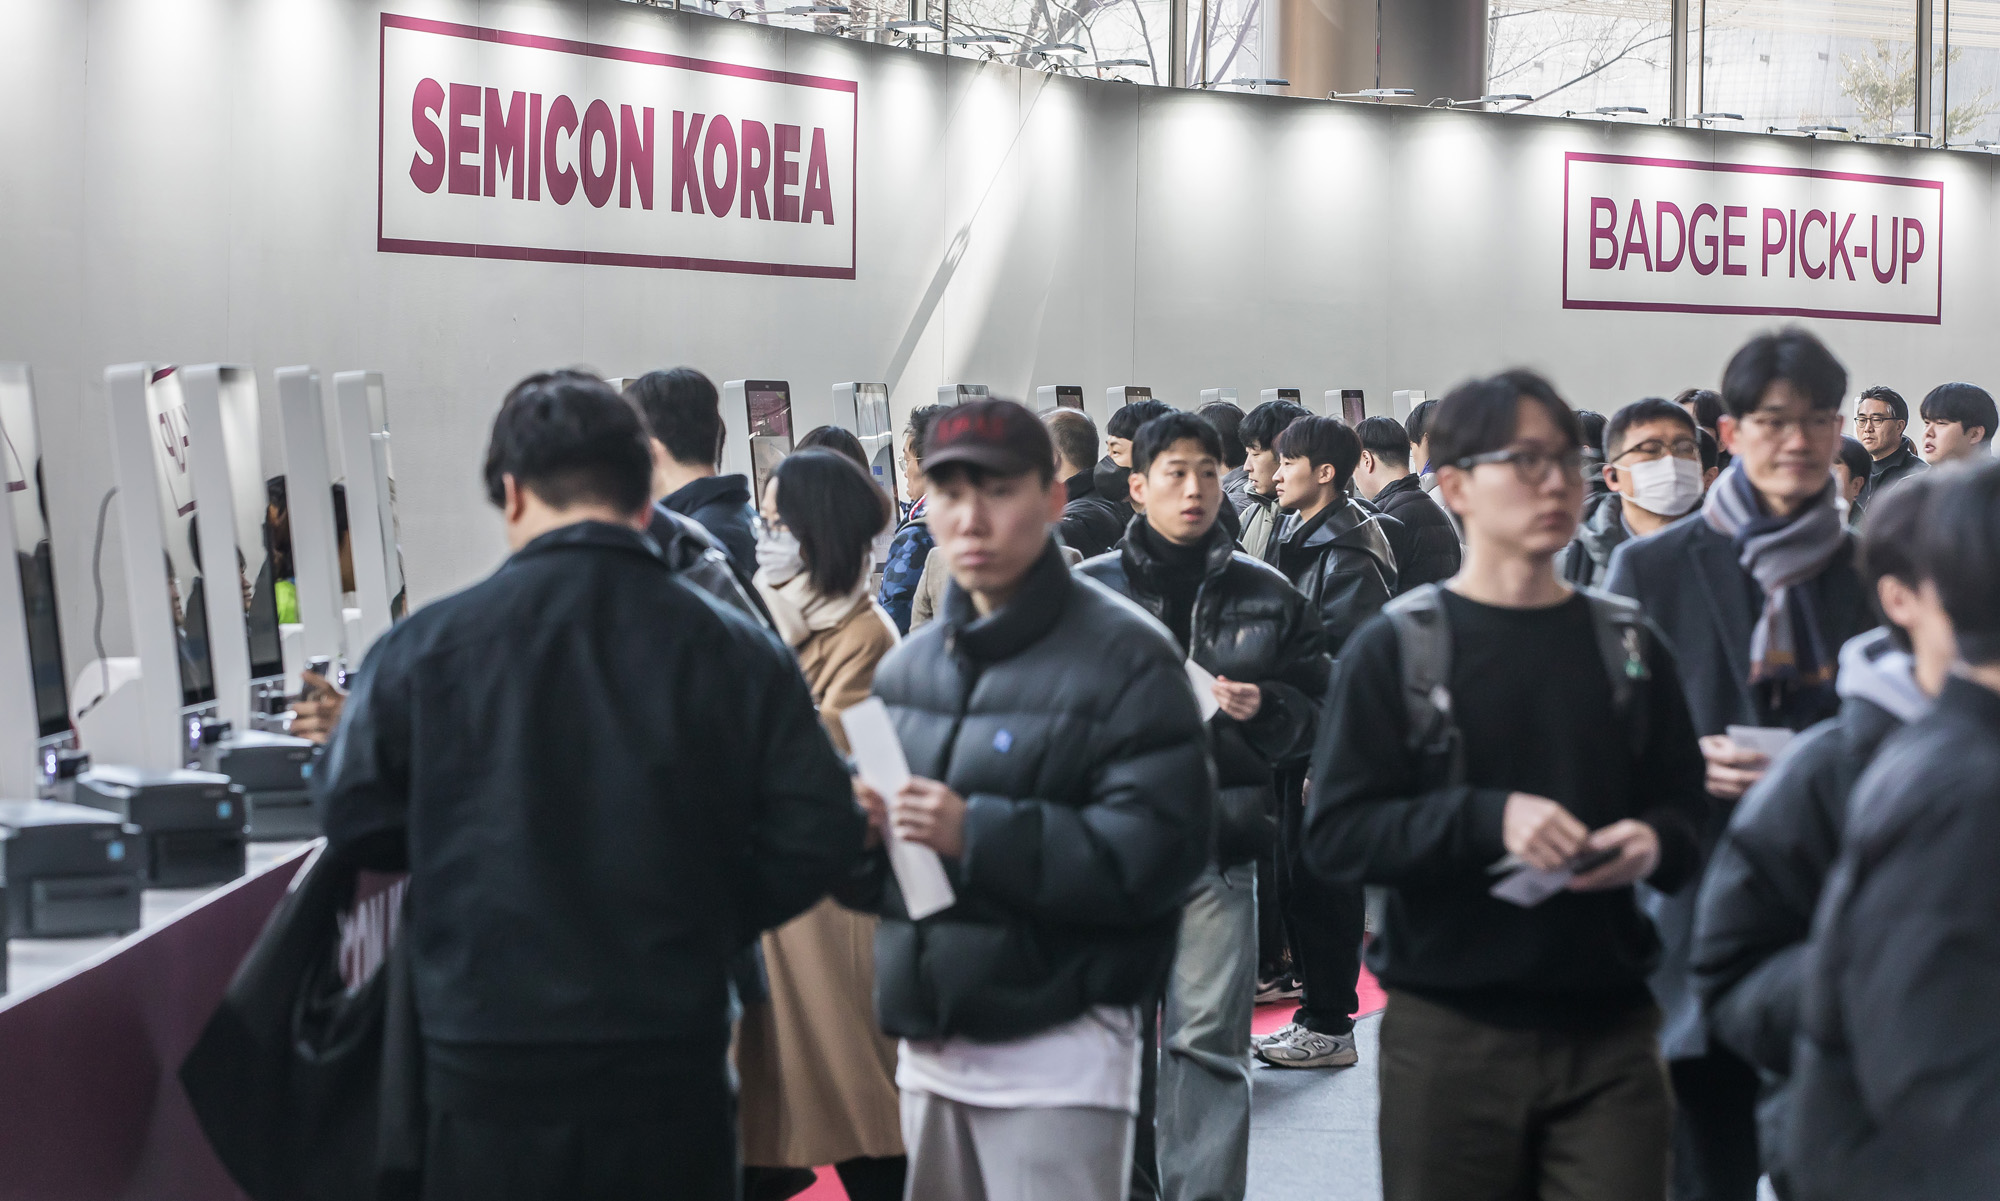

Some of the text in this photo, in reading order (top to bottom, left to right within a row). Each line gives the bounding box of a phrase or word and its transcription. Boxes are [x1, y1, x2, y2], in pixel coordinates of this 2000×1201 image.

[409, 78, 834, 225] SEMICON KOREA
[1589, 196, 1925, 284] BADGE PICK-UP
